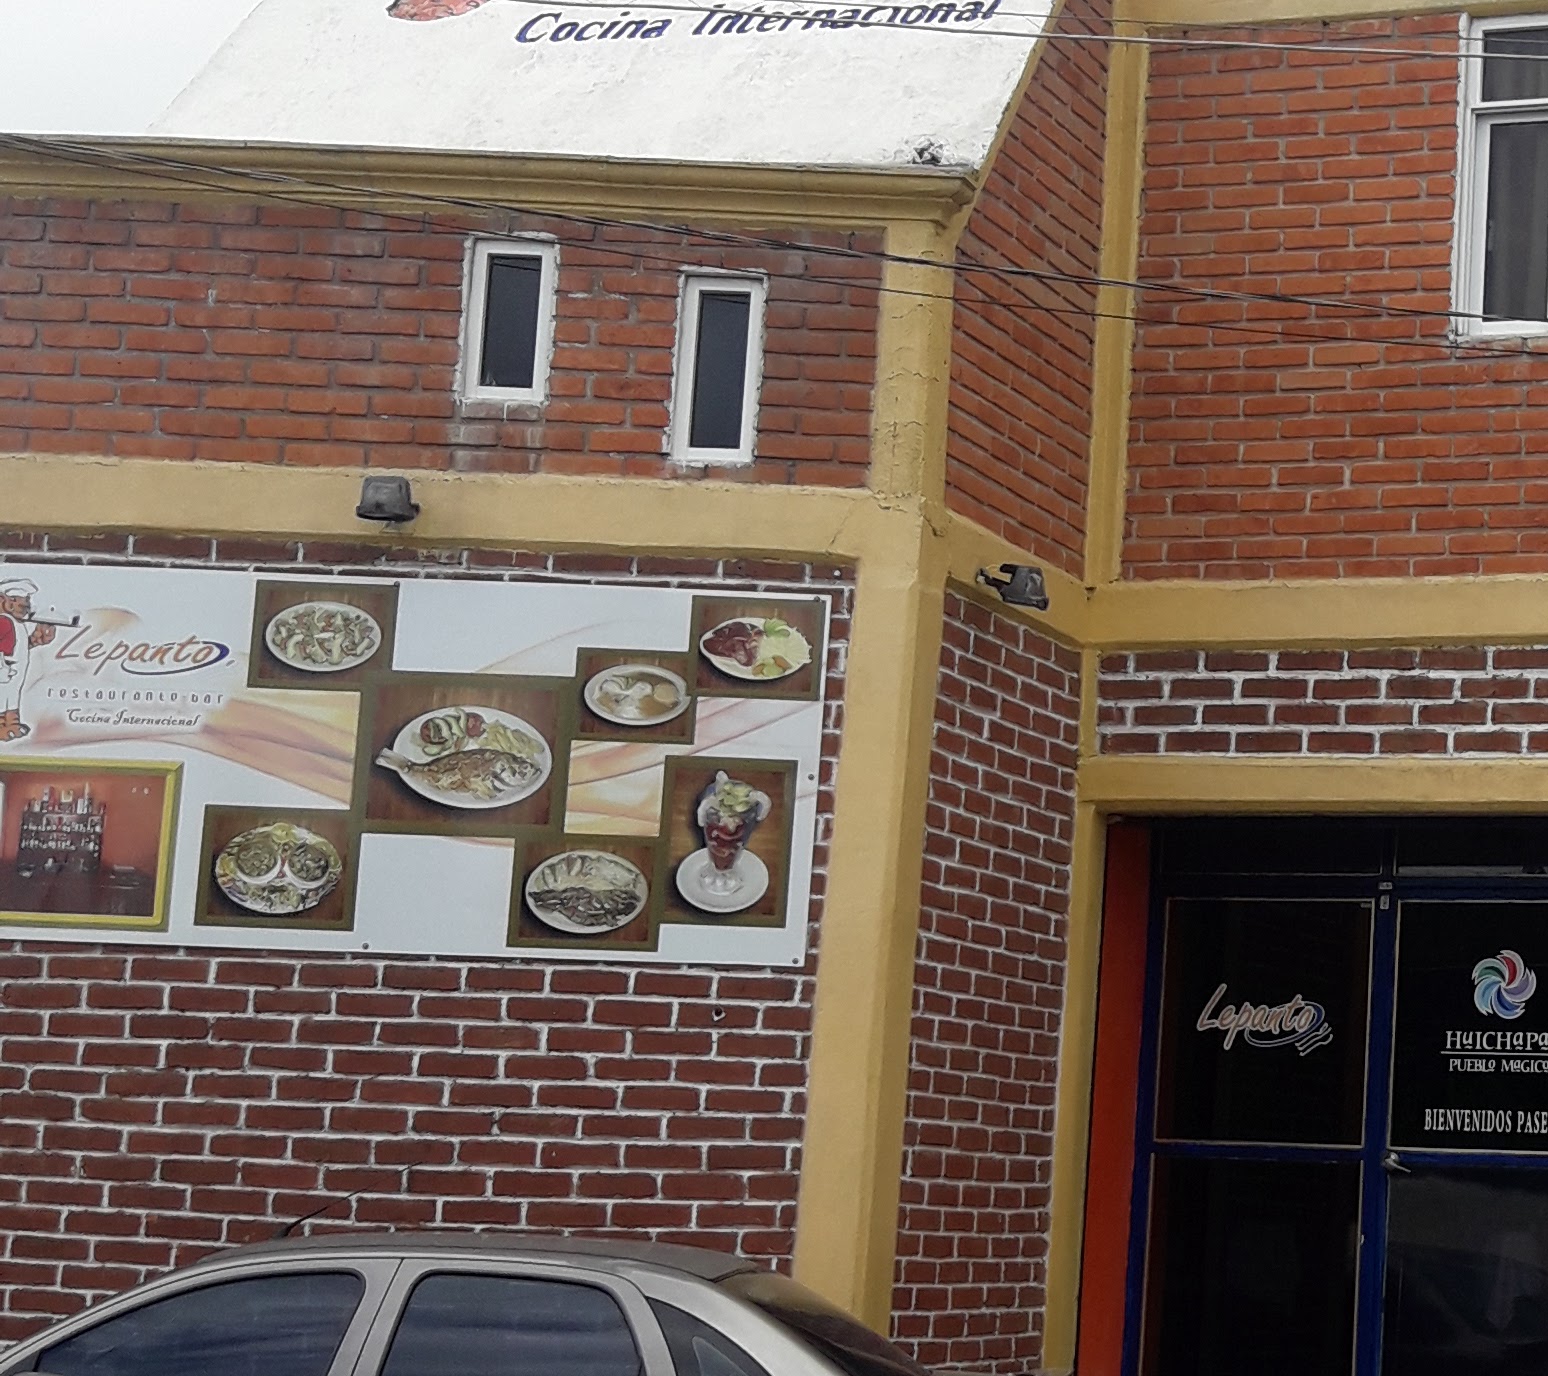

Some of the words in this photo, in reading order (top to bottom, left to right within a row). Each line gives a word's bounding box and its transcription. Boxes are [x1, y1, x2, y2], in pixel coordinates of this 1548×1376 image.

[515, 11, 668, 43] Cocina
[55, 625, 214, 675] Lepanto
[67, 708, 110, 724] Cocina
[113, 709, 201, 726] Internacional
[1196, 983, 1315, 1050] Lepanto
[1423, 1108, 1513, 1133] BIENVENIDOS
[1516, 1110, 1548, 1134] PASE
